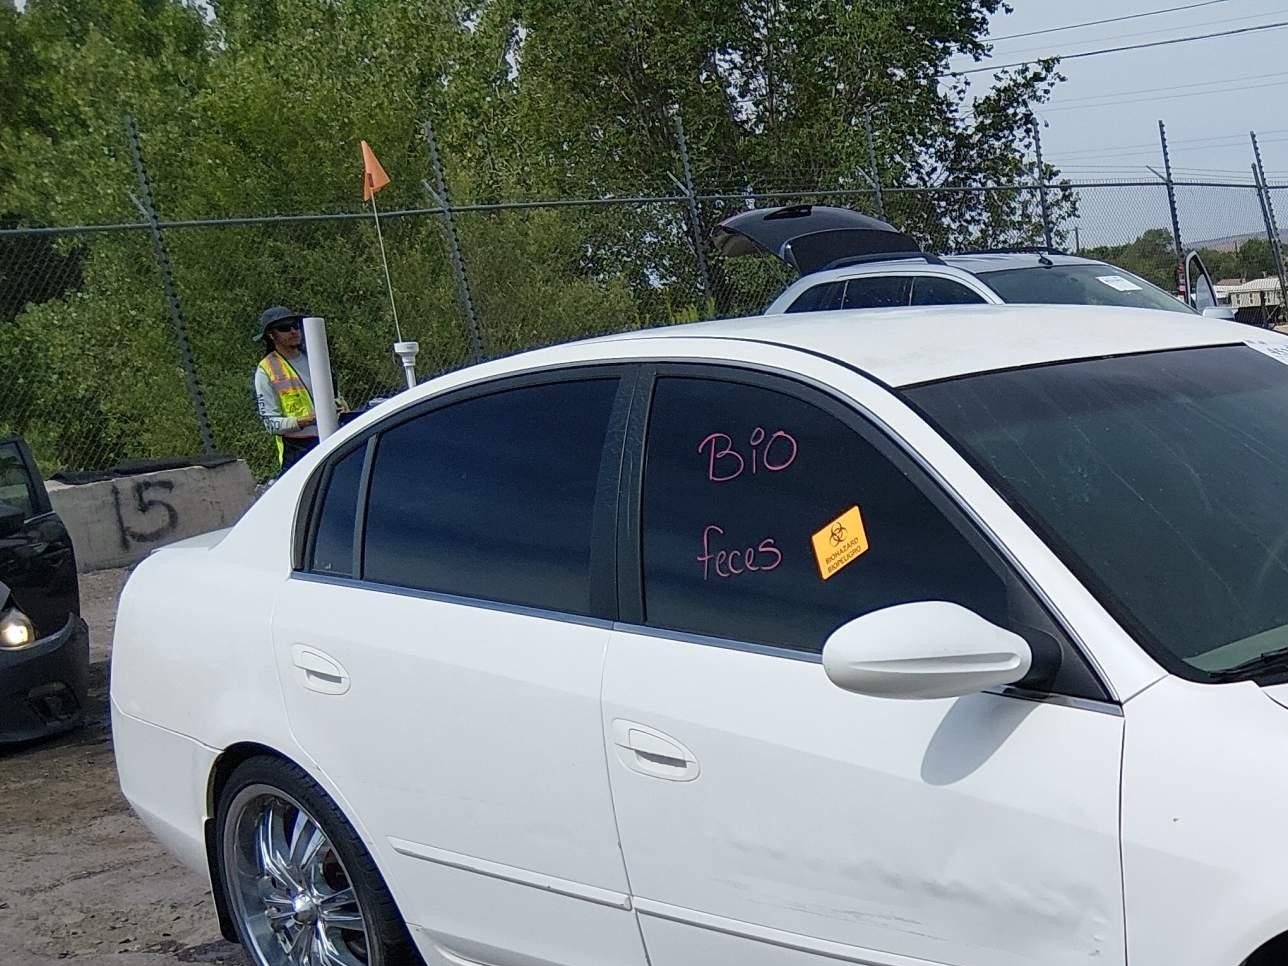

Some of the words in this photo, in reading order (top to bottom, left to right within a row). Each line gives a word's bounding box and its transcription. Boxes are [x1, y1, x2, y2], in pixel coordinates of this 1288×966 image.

[112, 480, 179, 550] 15
[697, 525, 783, 581] feces
[825, 537, 859, 566] BIOHAZARD
